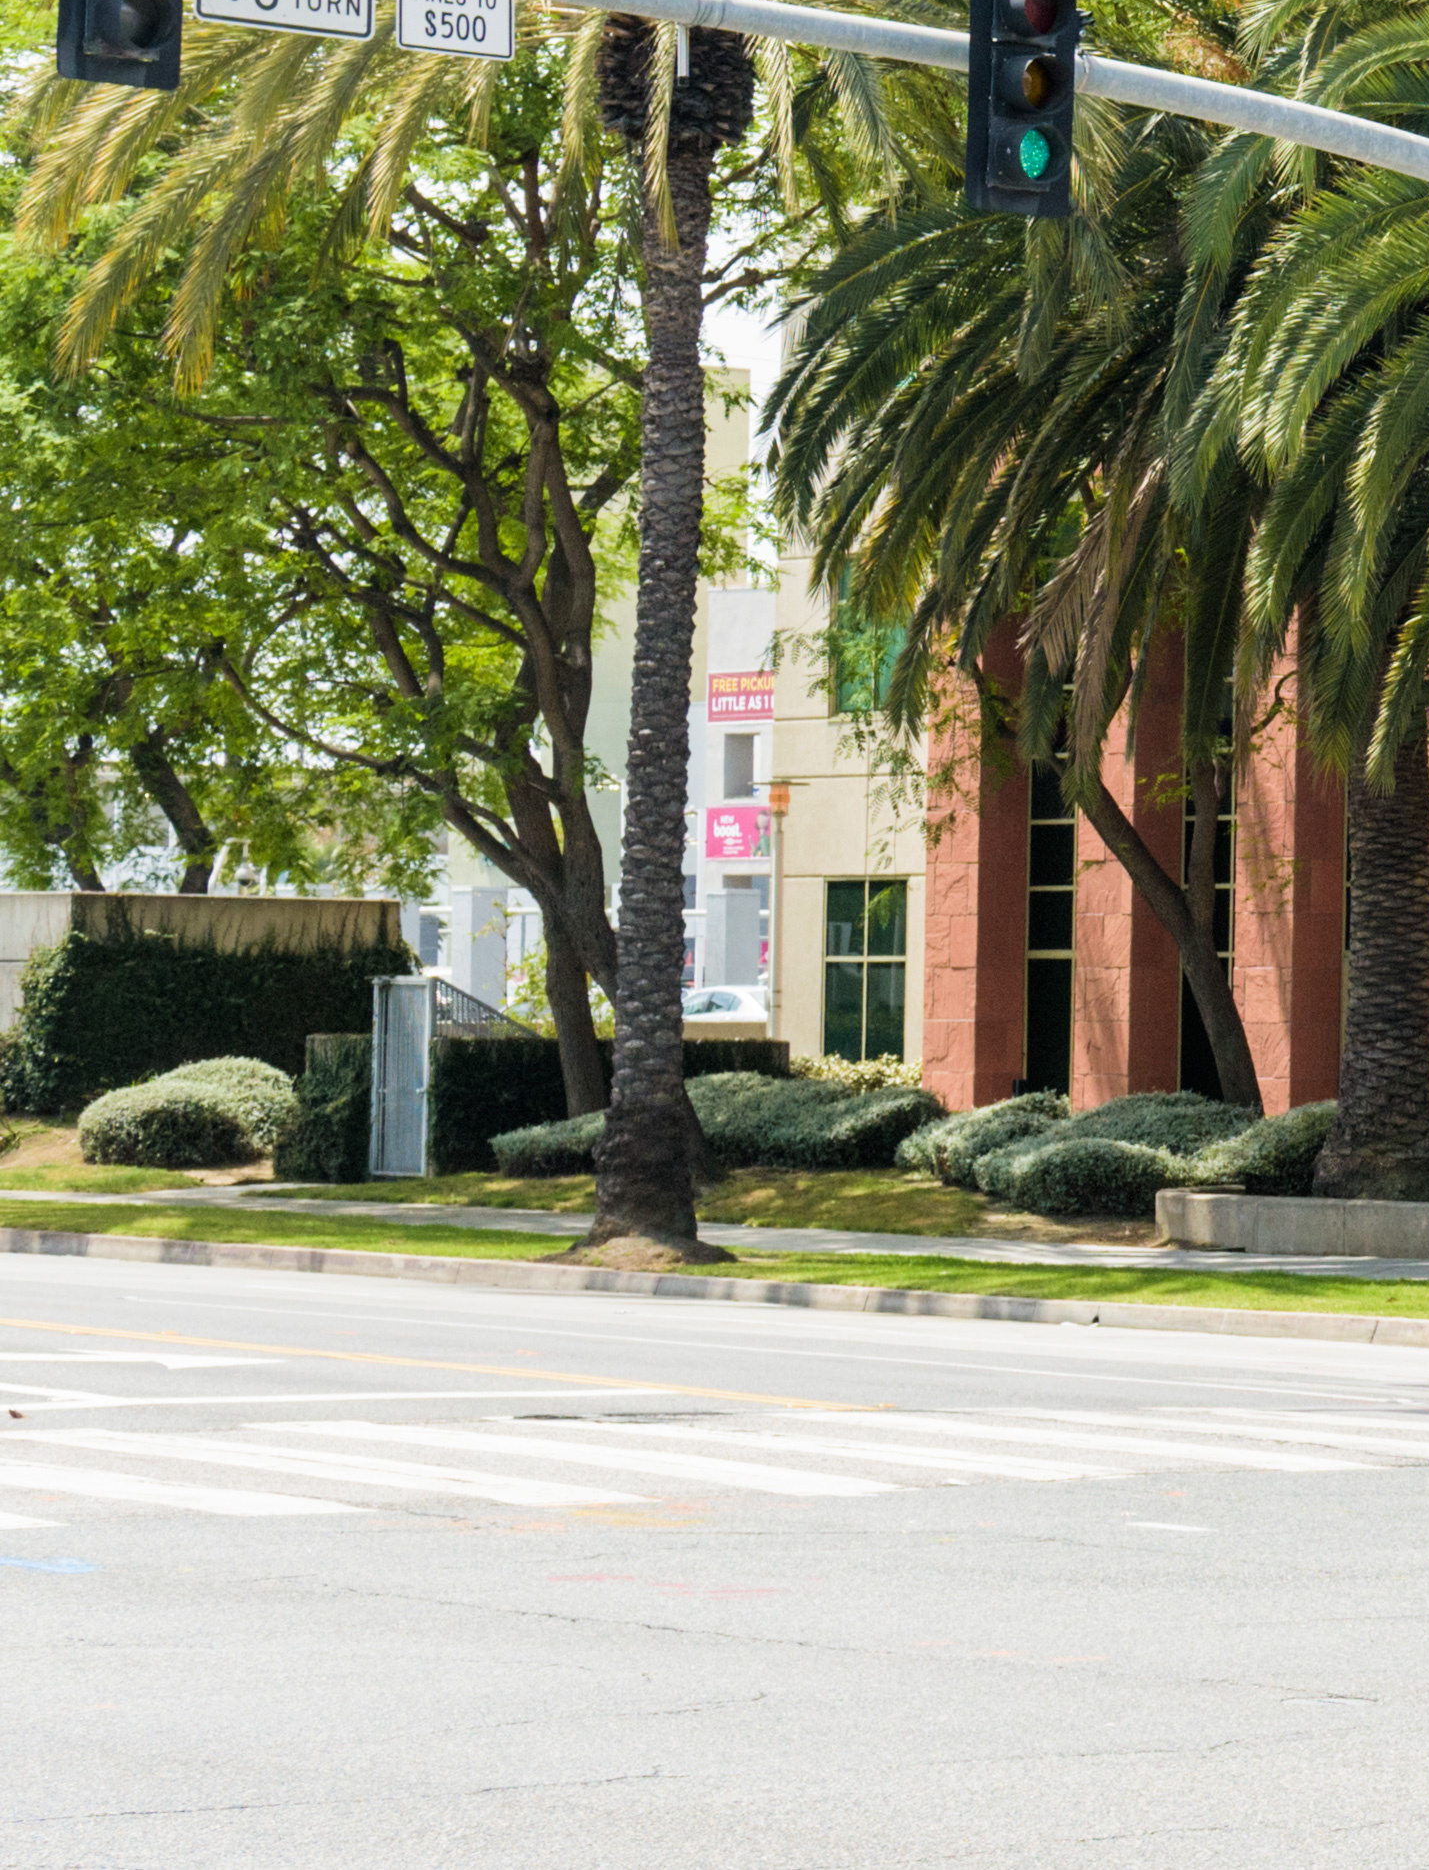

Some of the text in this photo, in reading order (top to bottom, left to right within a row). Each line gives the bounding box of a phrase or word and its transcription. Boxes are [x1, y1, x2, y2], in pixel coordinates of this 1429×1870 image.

[425, 9, 486, 42] $500
[712, 677, 738, 692] FREE
[712, 696, 746, 712] LITTLE
[747, 695, 762, 710] AS
[763, 695, 769, 710] 1
